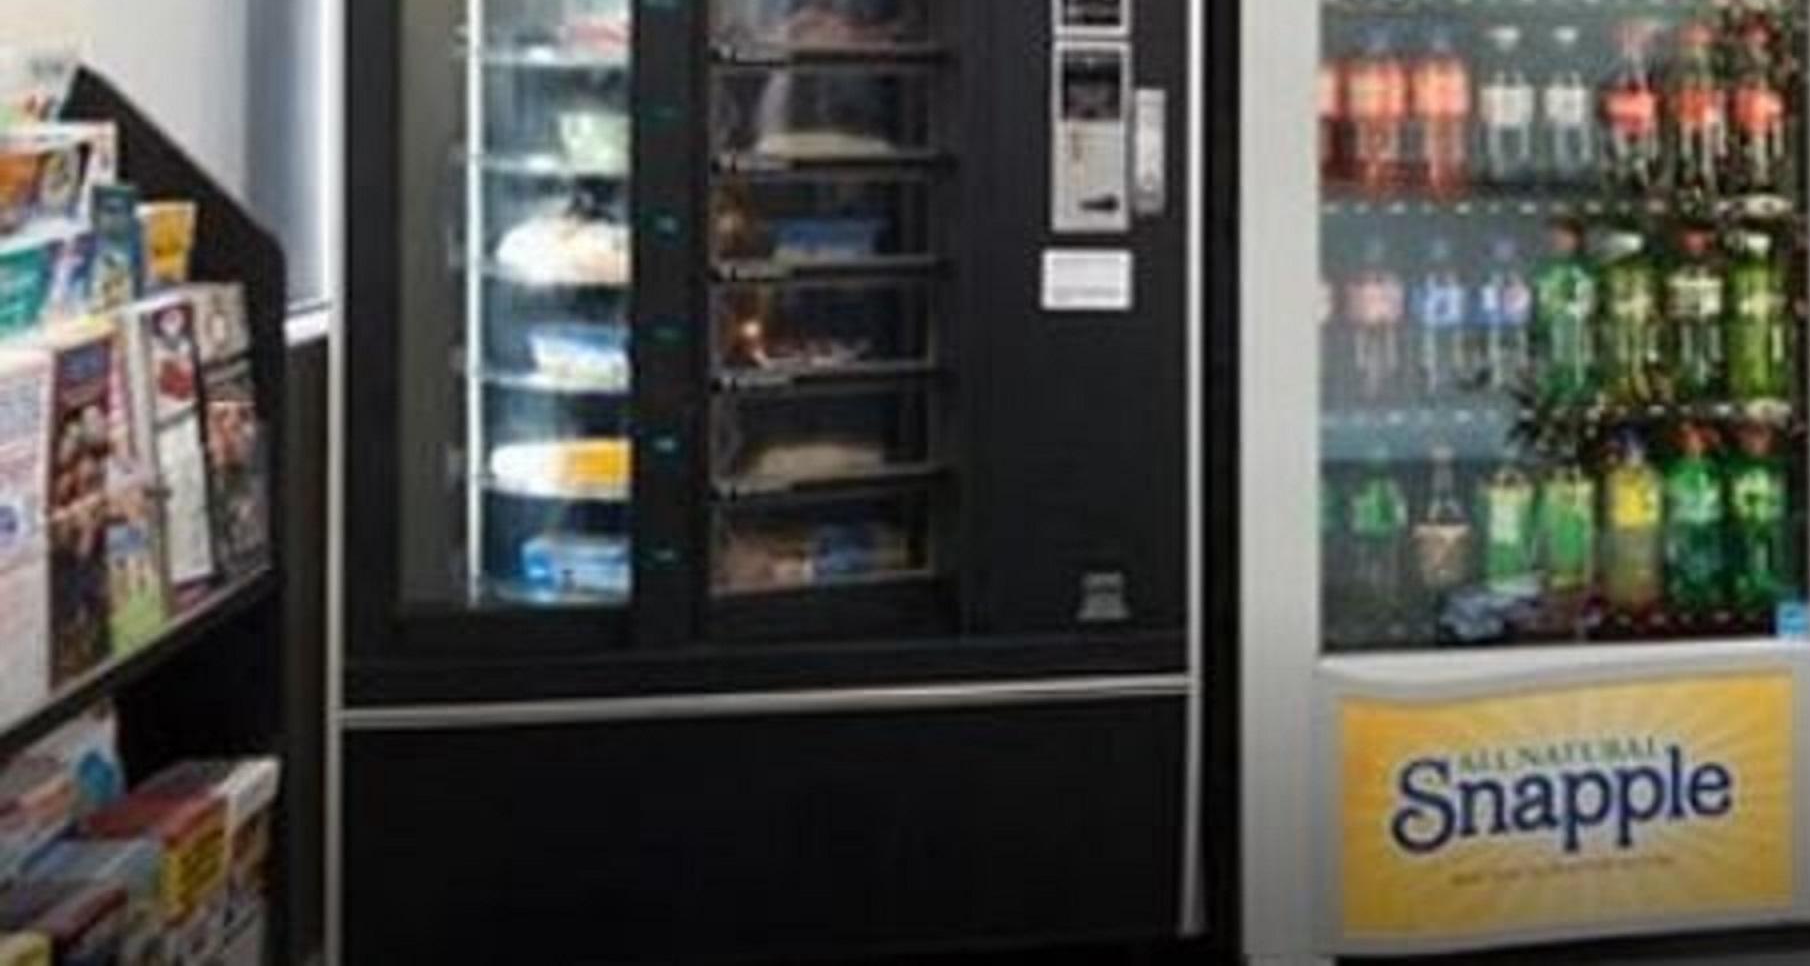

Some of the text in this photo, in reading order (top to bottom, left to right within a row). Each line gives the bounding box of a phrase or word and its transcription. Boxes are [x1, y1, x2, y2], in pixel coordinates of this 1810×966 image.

[1460, 735, 1660, 771] ALL NATURAL
[1391, 743, 1733, 854] Snapple
